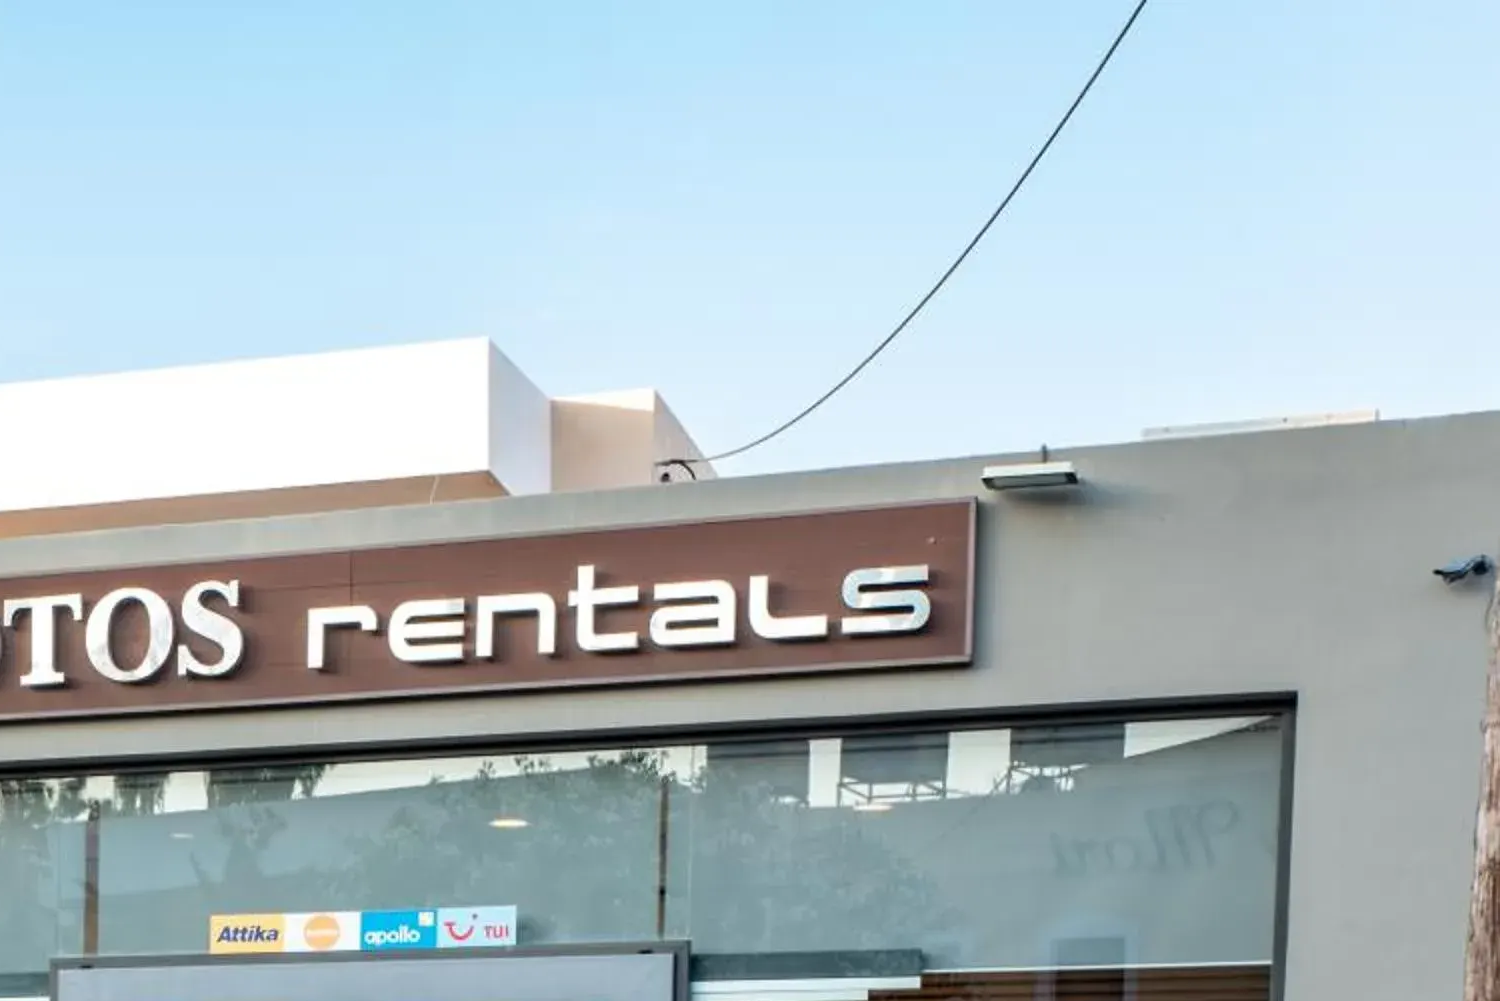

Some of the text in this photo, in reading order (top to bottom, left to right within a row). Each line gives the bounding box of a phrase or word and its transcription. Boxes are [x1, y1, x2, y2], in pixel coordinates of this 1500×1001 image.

[217, 925, 280, 944] Attika
[364, 927, 420, 946] apollo
[483, 924, 509, 939] TUI
